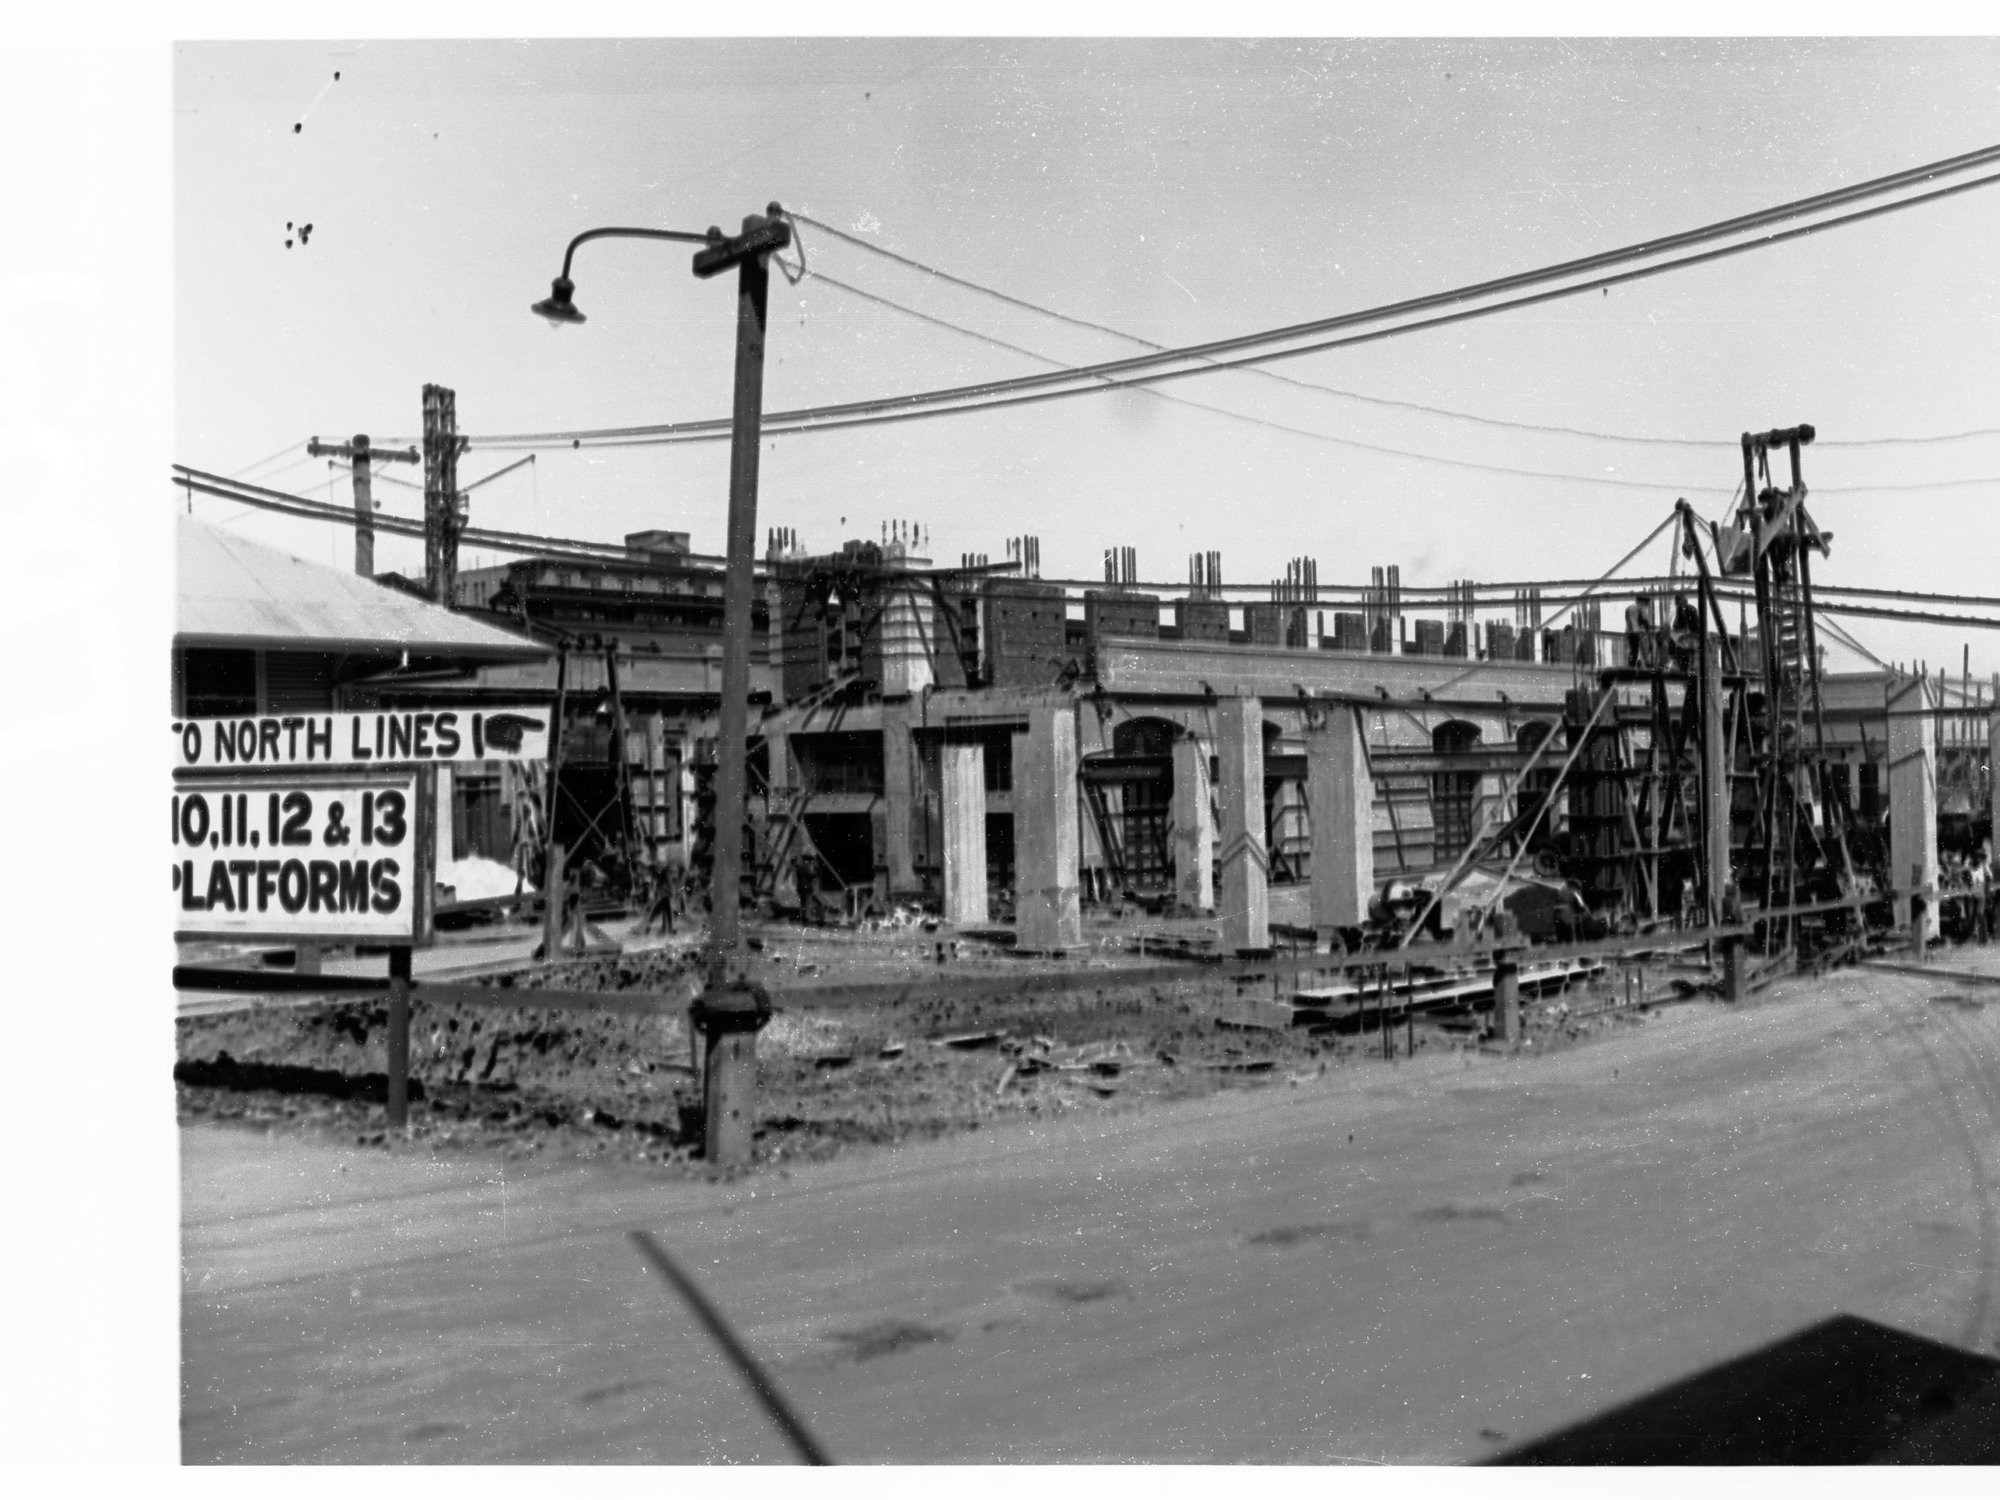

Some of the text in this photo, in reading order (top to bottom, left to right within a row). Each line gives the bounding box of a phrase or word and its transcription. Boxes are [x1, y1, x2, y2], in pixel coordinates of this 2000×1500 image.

[214, 715, 333, 763] NORTH
[352, 712, 461, 759] LINES
[323, 801, 351, 847] &
[361, 789, 407, 847] 13
